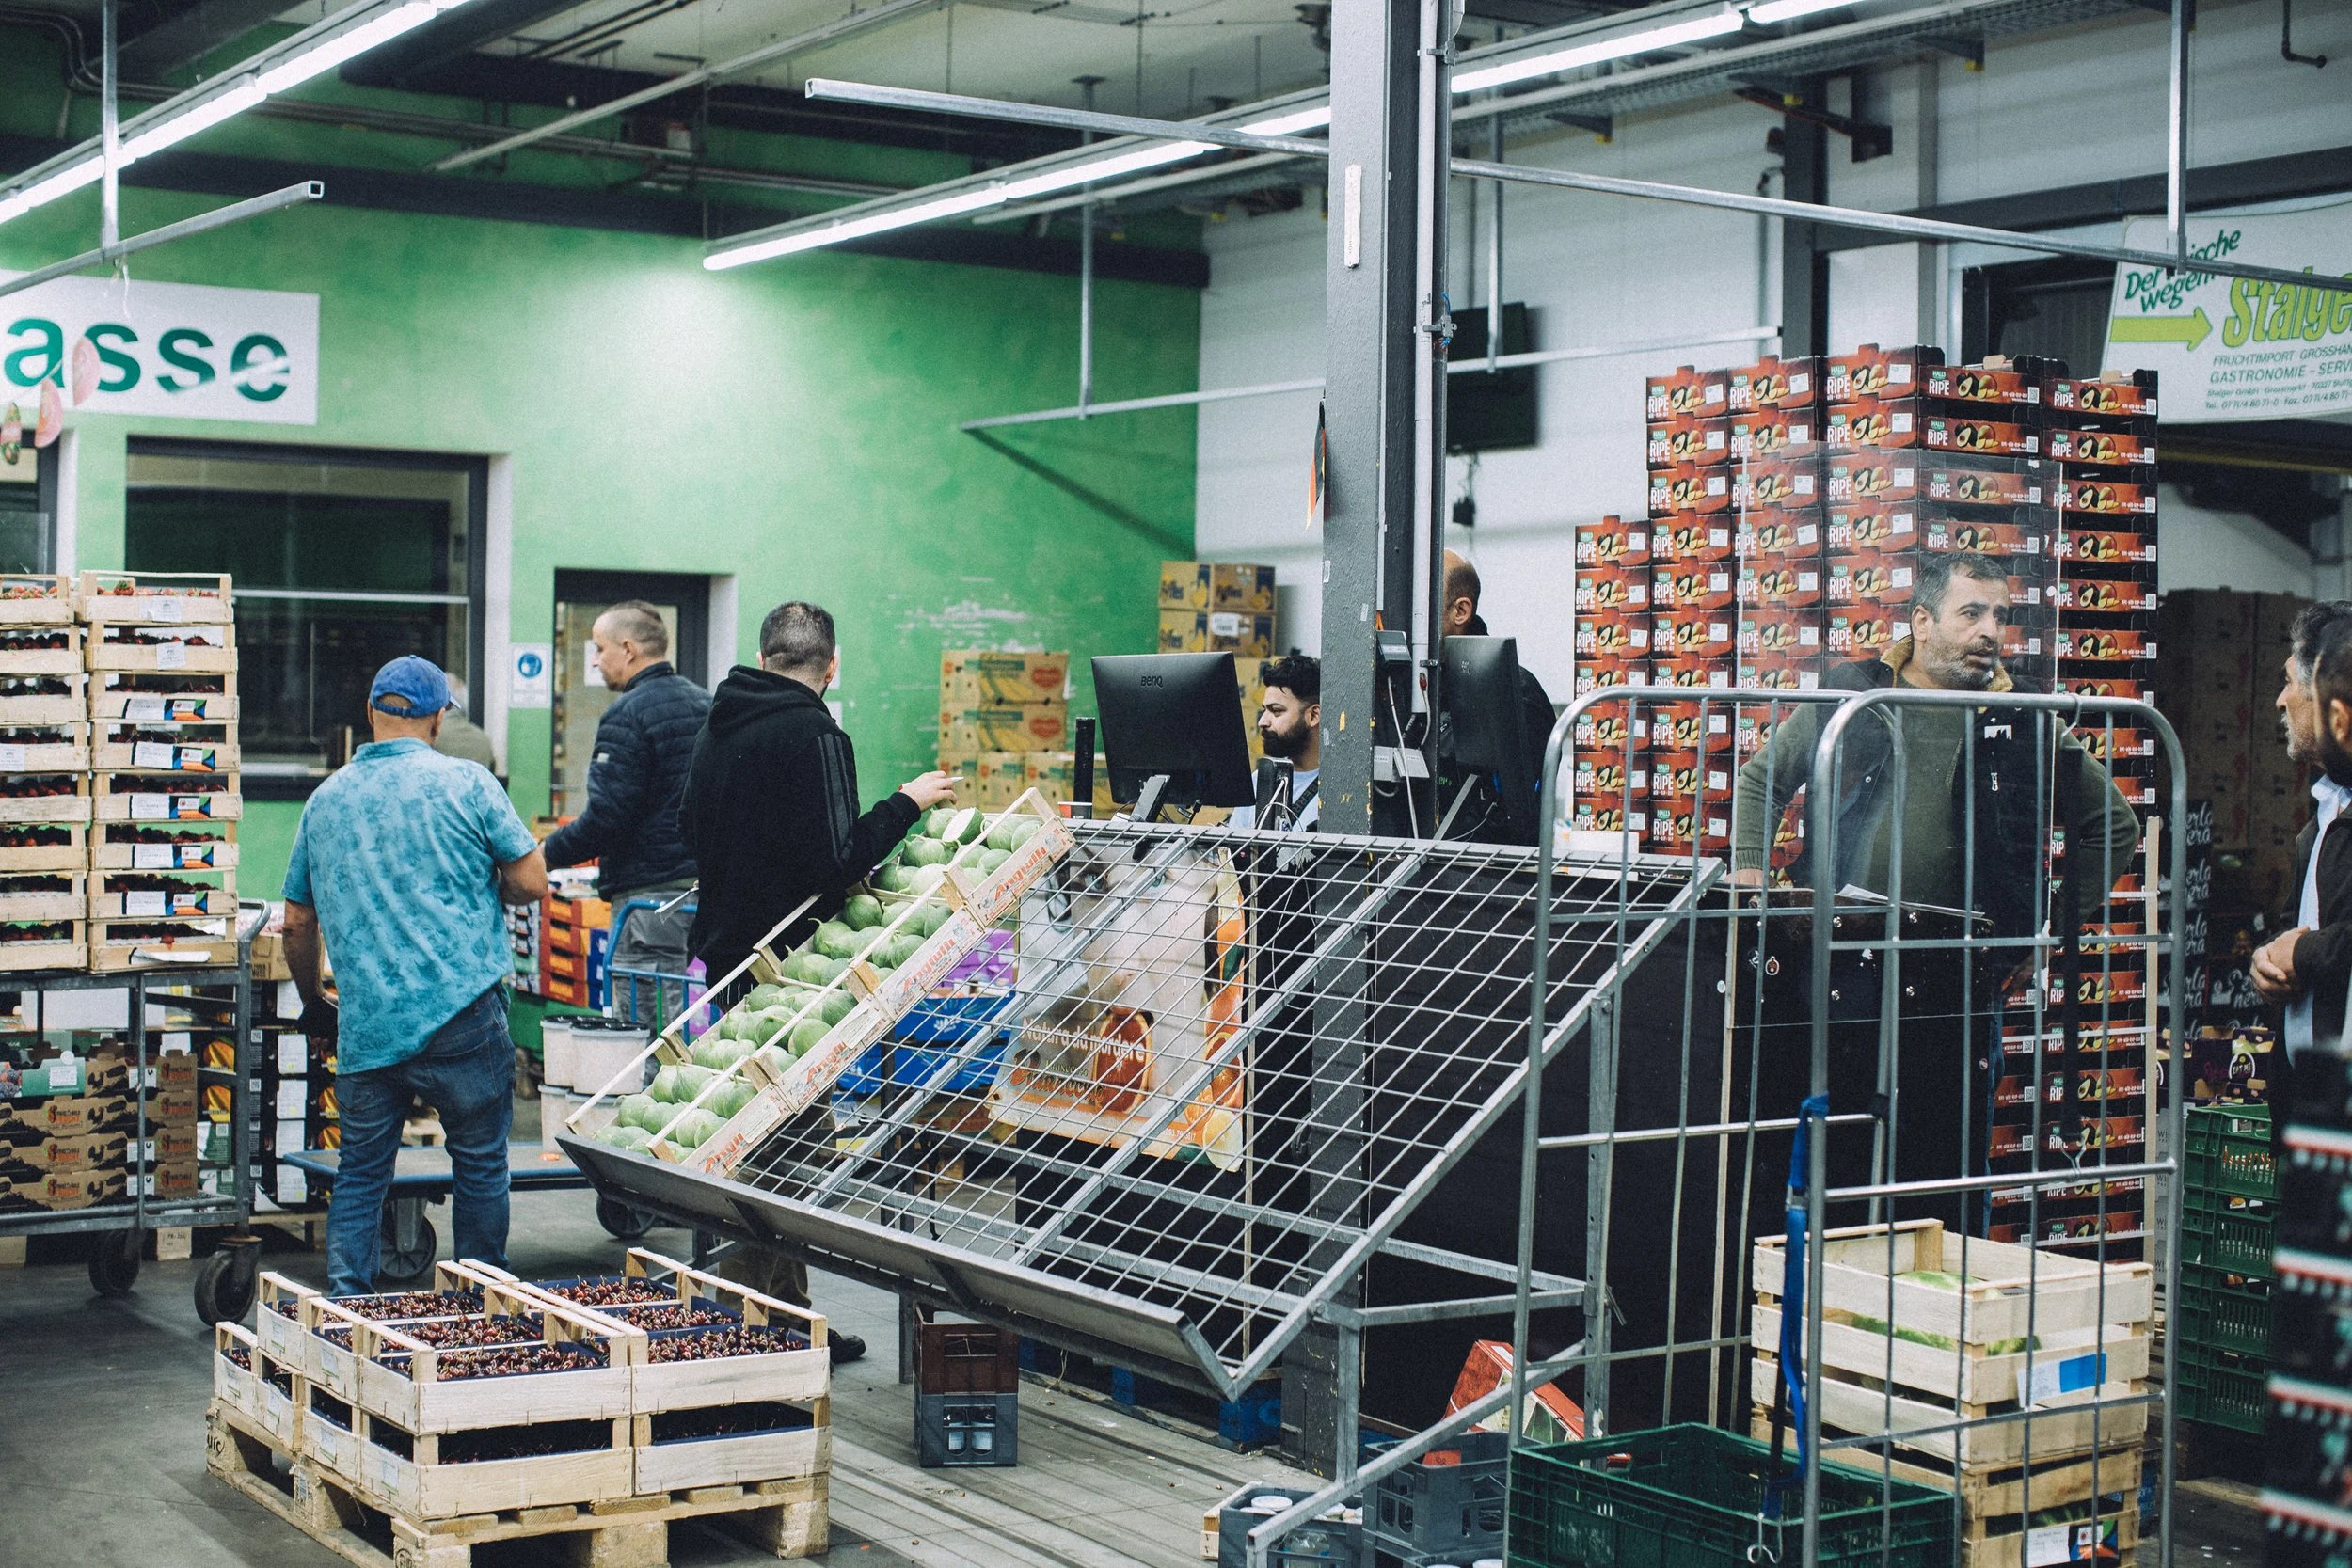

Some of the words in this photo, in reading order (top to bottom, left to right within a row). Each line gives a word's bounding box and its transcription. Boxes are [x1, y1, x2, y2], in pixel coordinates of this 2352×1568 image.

[2125, 267, 2164, 300] Der
[2222, 266, 2352, 347] Staige
[2213, 350, 2296, 366] FRUCHTIMPORT
[2210, 365, 2306, 384] GASTRONOMIE
[1827, 375, 1850, 395] RIPE
[1929, 378, 1949, 395] RIPE
[1729, 385, 1752, 404] RIPE
[2054, 391, 2074, 408] RIPE
[1648, 395, 1668, 413] RIPE
[1827, 425, 1851, 443] RIPE
[1927, 429, 1948, 446] RIPE
[1649, 439, 1670, 457] RIPE
[2052, 441, 2072, 457] RIPE
[1829, 477, 1851, 496] RIPE
[1930, 482, 1951, 499] RIPE
[1650, 487, 1671, 504] RIPE
[2053, 492, 2072, 508] RPE
[1735, 532, 1756, 550] RPE
[1829, 524, 1851, 543] RIPE
[1928, 532, 1949, 549] RIPE
[1577, 541, 1597, 559] RIPE
[1652, 535, 1673, 552] RIPE
[2054, 541, 2072, 557] RPE
[1654, 582, 1674, 599] RIPE
[1829, 576, 1851, 595] RIPE
[1576, 588, 1596, 605] RIPE
[1577, 631, 1596, 647] RIPE
[1654, 629, 1675, 647] RIPE
[1739, 630, 1759, 648] IPE
[1829, 628, 1851, 647] RIPE
[1140, 675, 1163, 688] BenQ
[1576, 723, 1596, 740] RIPE
[1653, 723, 1674, 740] RIPE
[1575, 770, 1596, 788] RIPE
[1653, 772, 1674, 791] RIPE
[1653, 818, 1674, 836] RIPE
[2051, 841, 2065, 855] RIP
[2050, 989, 2064, 1003] RIP
[2048, 1038, 2064, 1052] RIP
[2050, 1086, 2064, 1101] RIP
